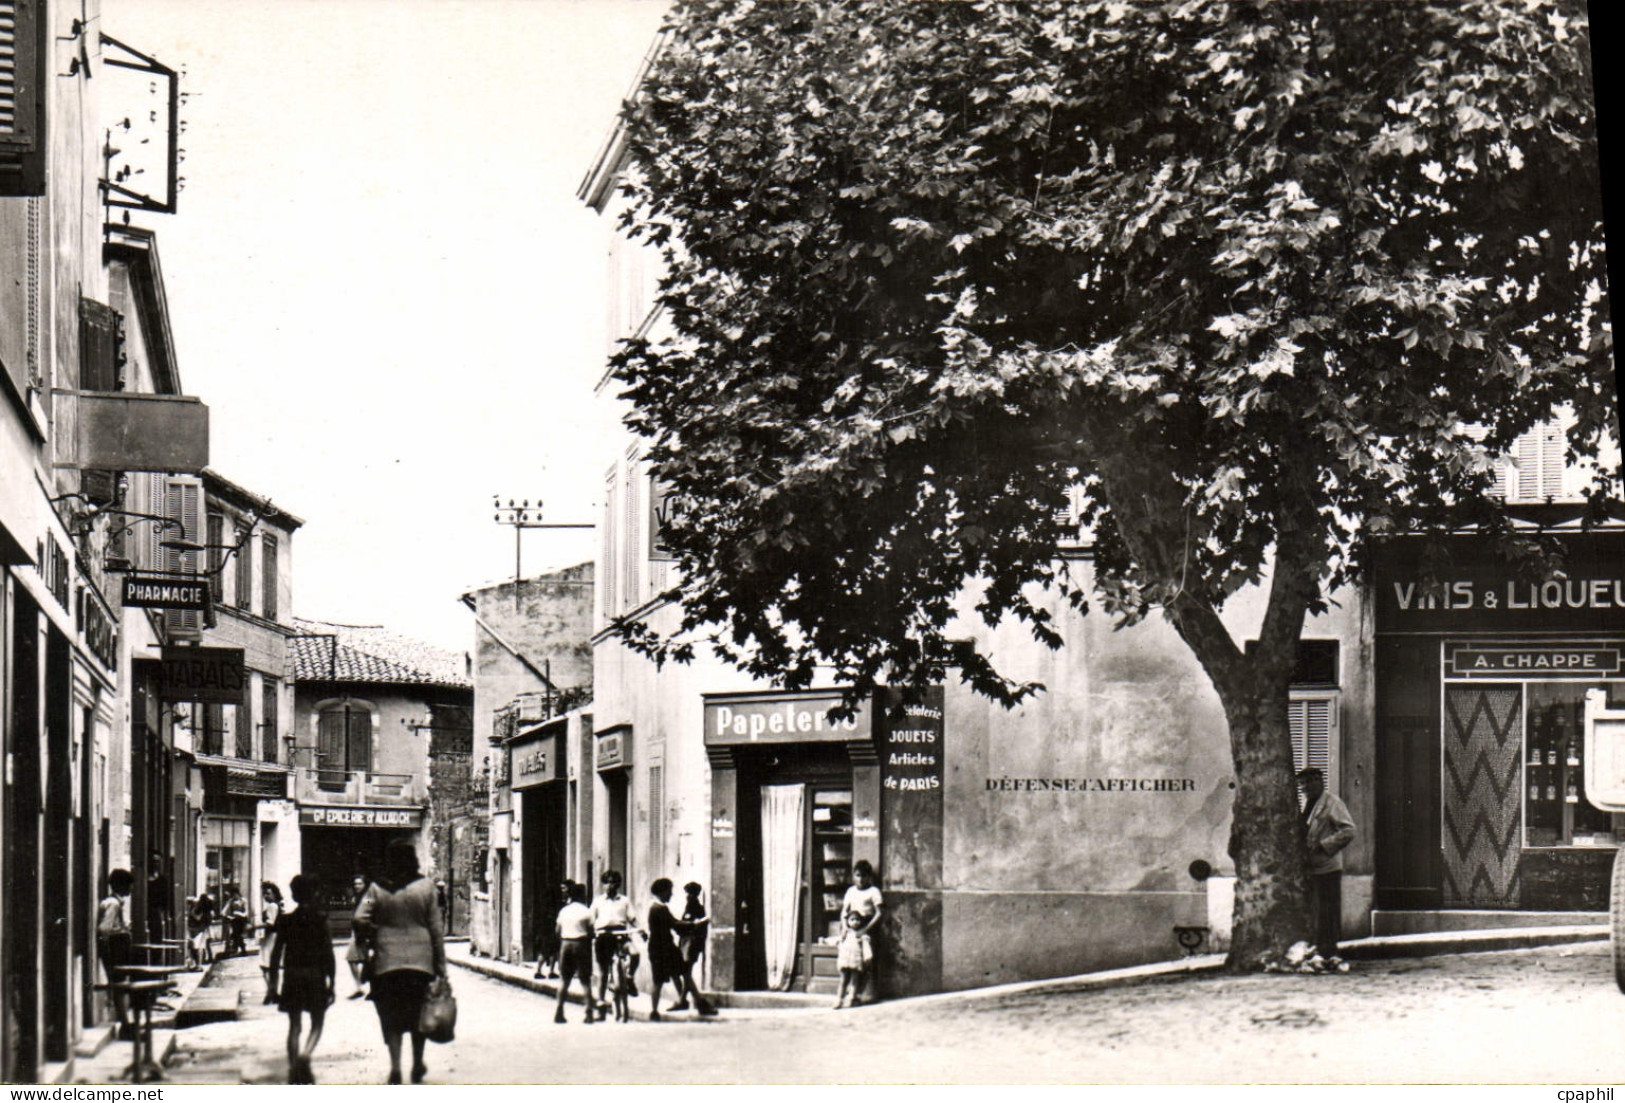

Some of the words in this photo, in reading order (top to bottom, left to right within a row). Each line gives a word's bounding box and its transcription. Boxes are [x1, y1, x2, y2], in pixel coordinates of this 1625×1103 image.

[127, 583, 203, 603] PHARMACIE
[1483, 590, 1499, 609] &
[1474, 654, 1495, 668] A.
[1502, 654, 1598, 668] CHAPPE
[889, 730, 936, 743] JOUETS
[888, 753, 936, 765] Articles
[884, 776, 898, 789] de
[900, 775, 940, 791] PARIS
[985, 775, 1076, 791] DÉFENSE
